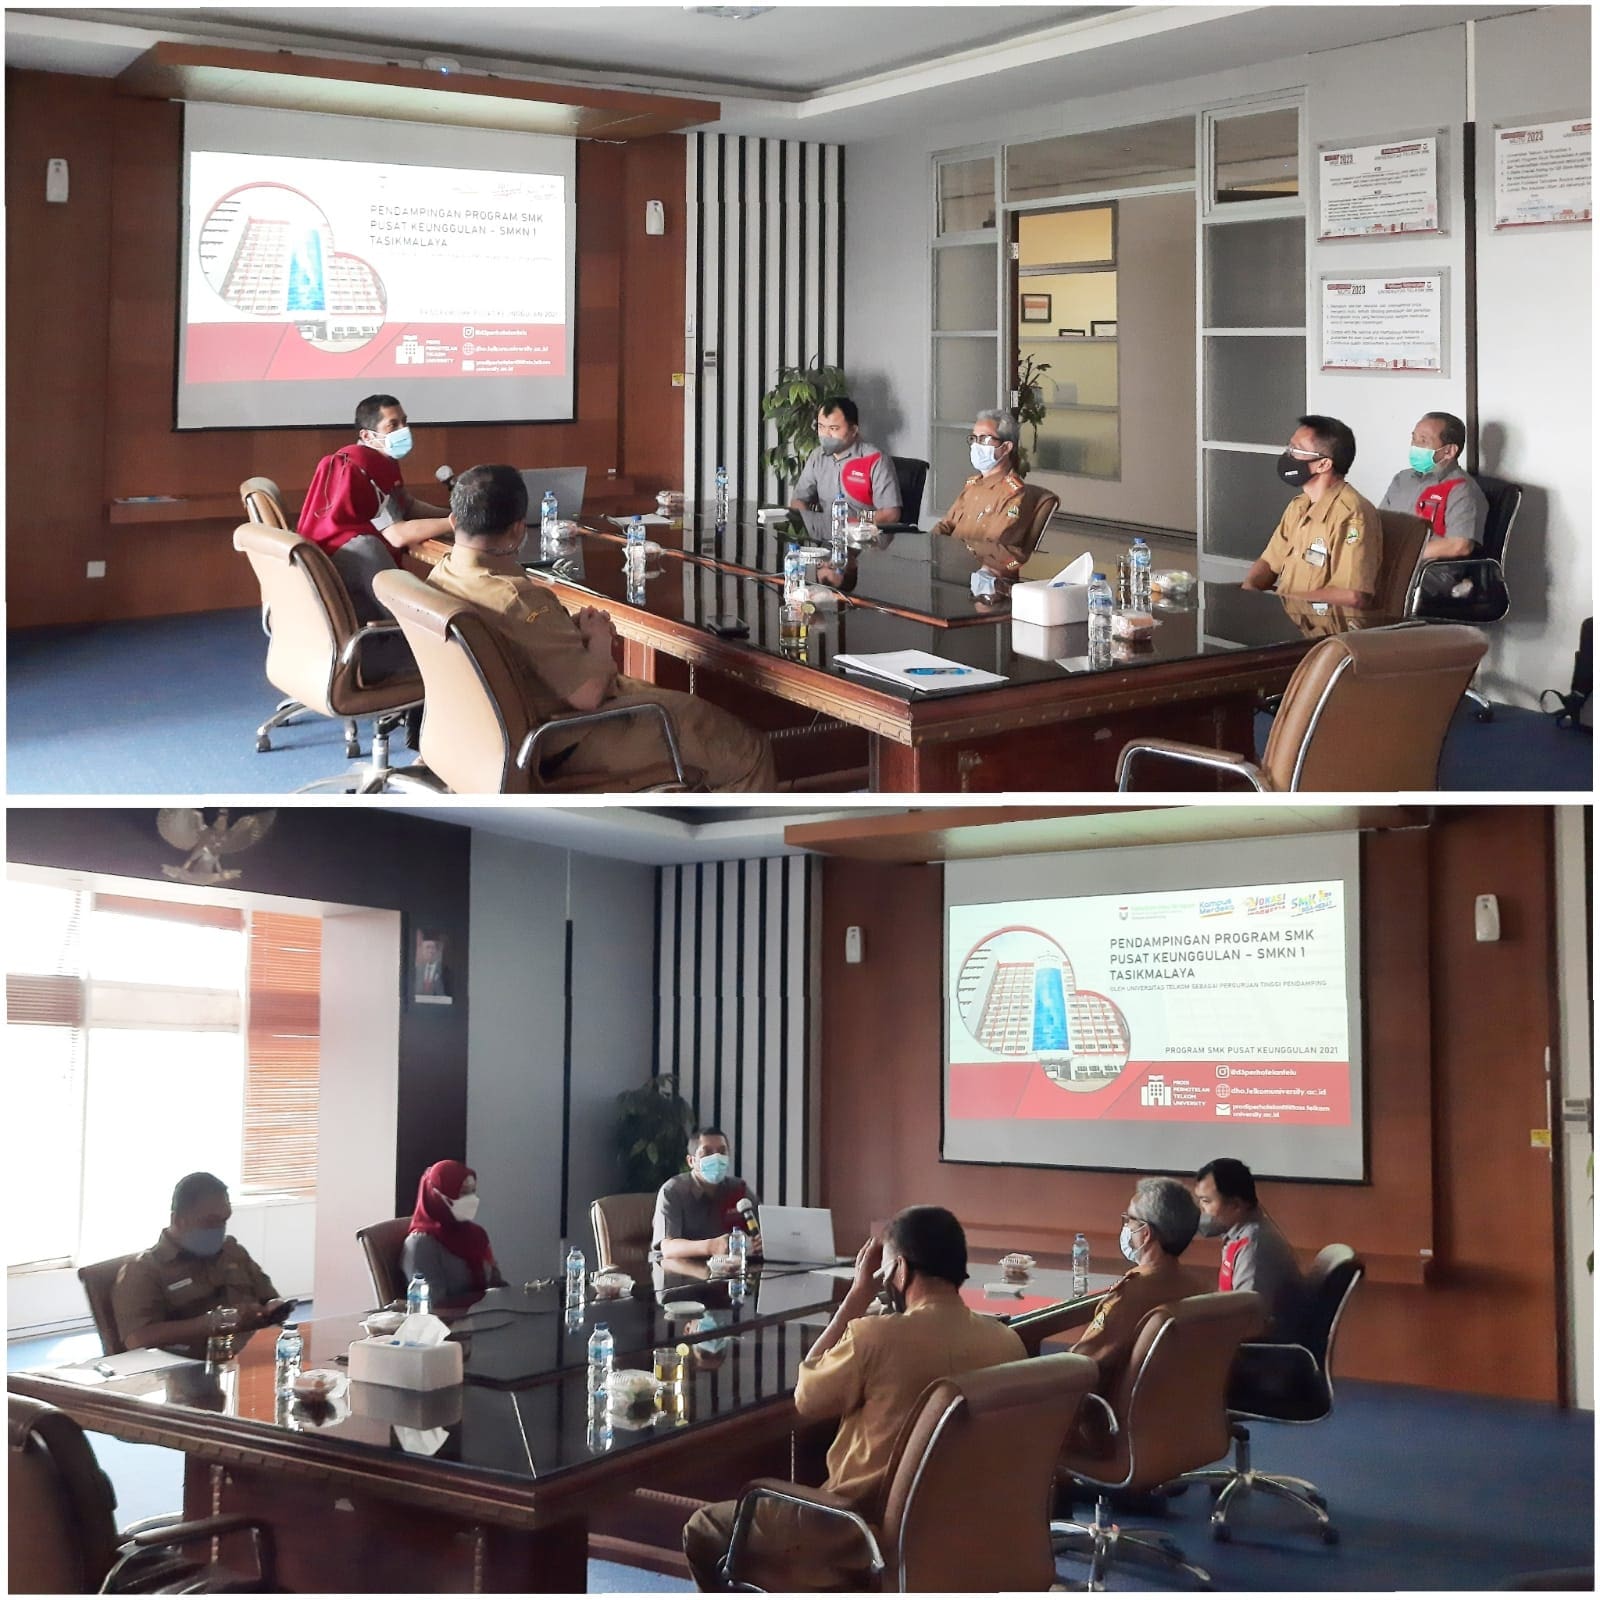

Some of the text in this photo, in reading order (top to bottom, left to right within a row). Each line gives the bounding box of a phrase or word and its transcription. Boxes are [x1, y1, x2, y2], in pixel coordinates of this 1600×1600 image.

[370, 204, 544, 223] PENDAMPINGAN PROGRAM SMK
[370, 220, 407, 231] PUSAT
[411, 222, 487, 235] KEUNGGULAN
[499, 225, 530, 236] SMKN
[369, 235, 448, 247] TASIKMALAYA
[1351, 285, 1366, 295] 2023
[1110, 929, 1315, 950] PENDAMPINGAN PROGRAM SMK
[1110, 952, 1150, 965] PUSAT
[1152, 949, 1241, 963] KEUNGGULAN
[1257, 947, 1296, 960] SMKN
[1300, 946, 1305, 957] 1
[1109, 967, 1196, 981] TASIKMALAYA
[1165, 1046, 1338, 1054] PROGRAM SMK PUSAT KEUNGGULAN 2021
